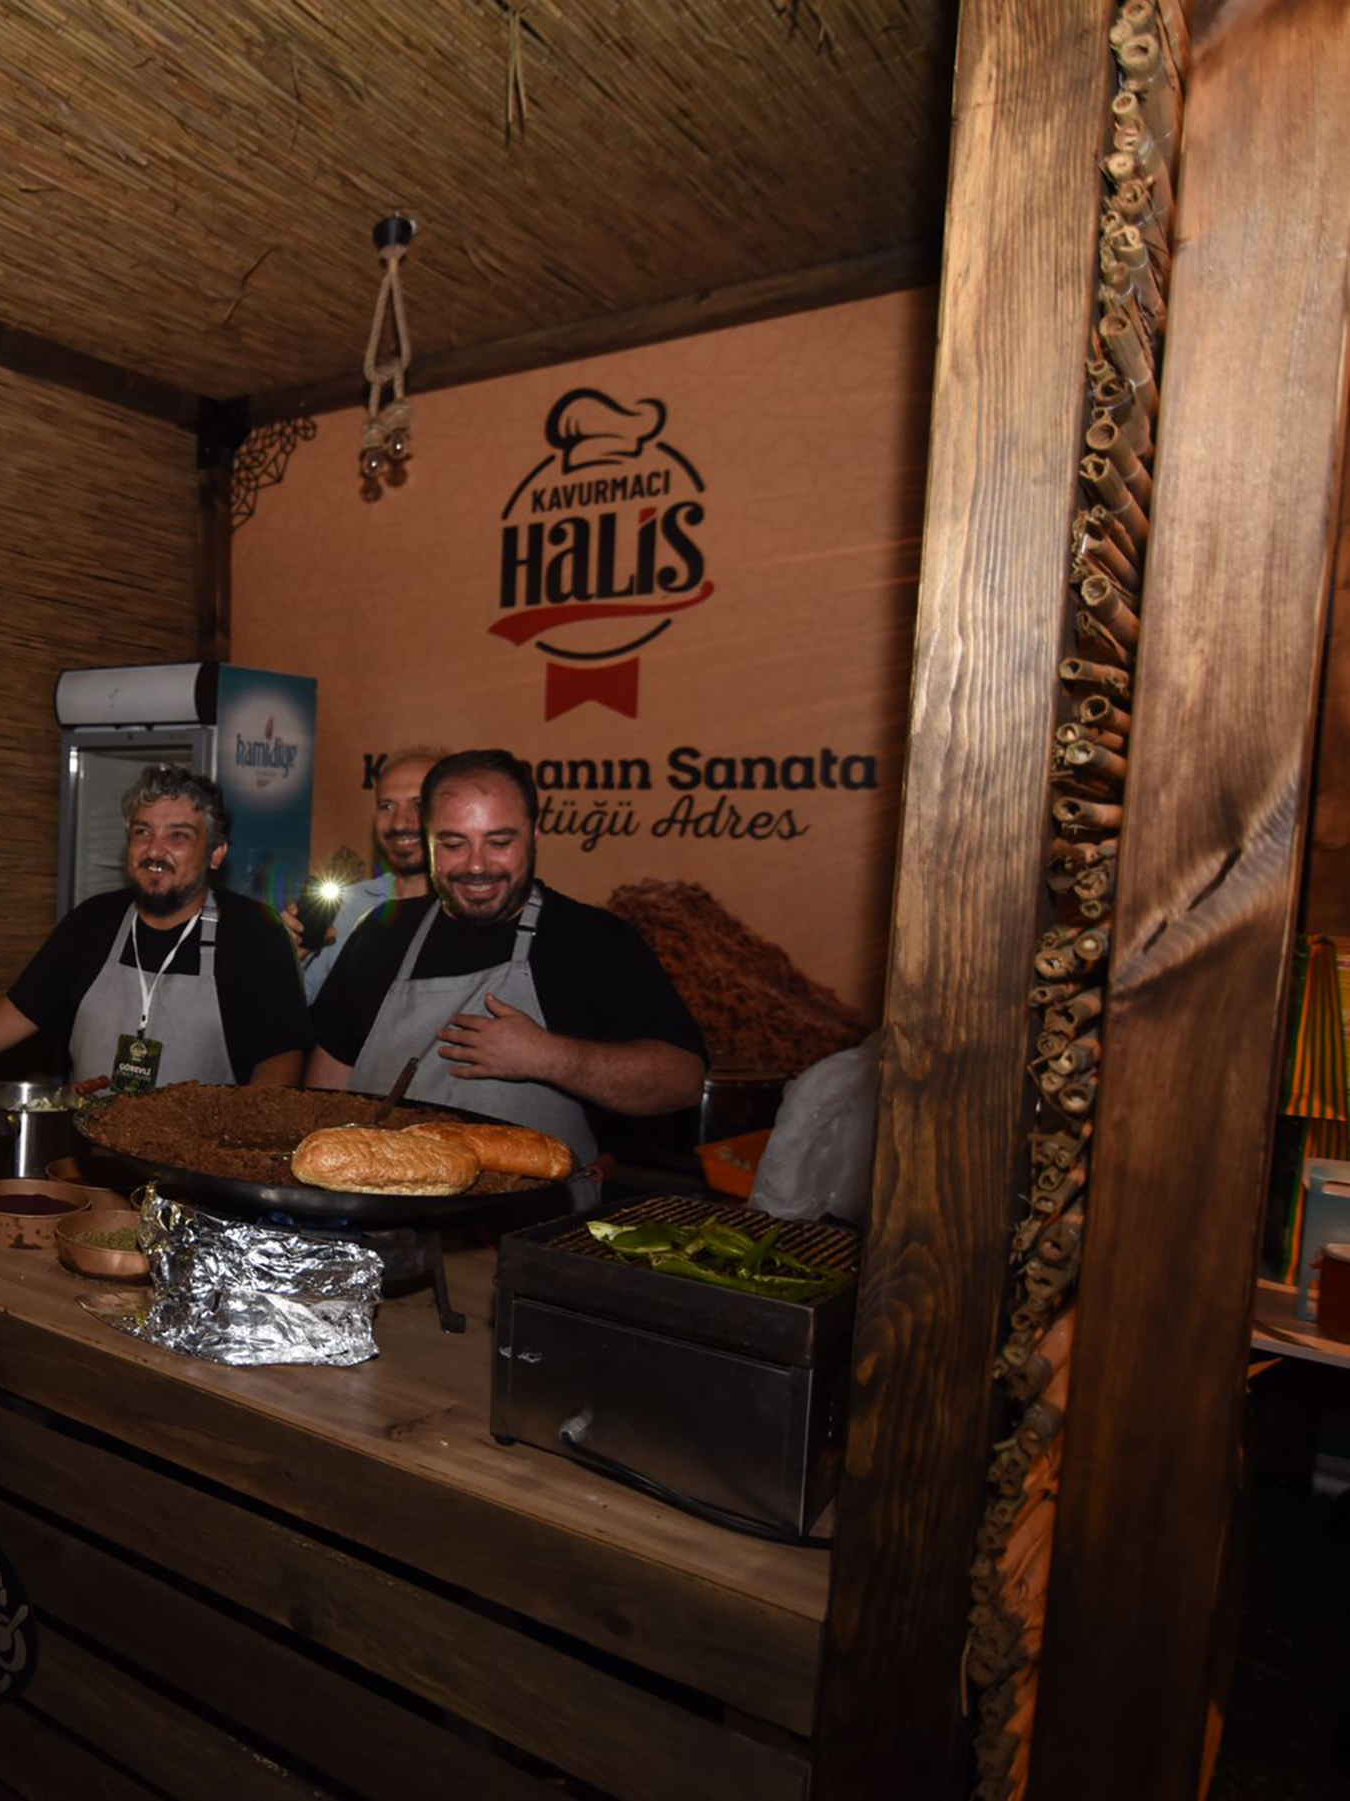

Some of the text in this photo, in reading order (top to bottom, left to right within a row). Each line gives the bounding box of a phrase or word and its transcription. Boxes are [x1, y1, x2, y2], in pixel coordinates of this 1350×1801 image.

[531, 470, 670, 514] KAVURMACI
[667, 747, 878, 790] Sanata
[650, 794, 810, 840] Adres
